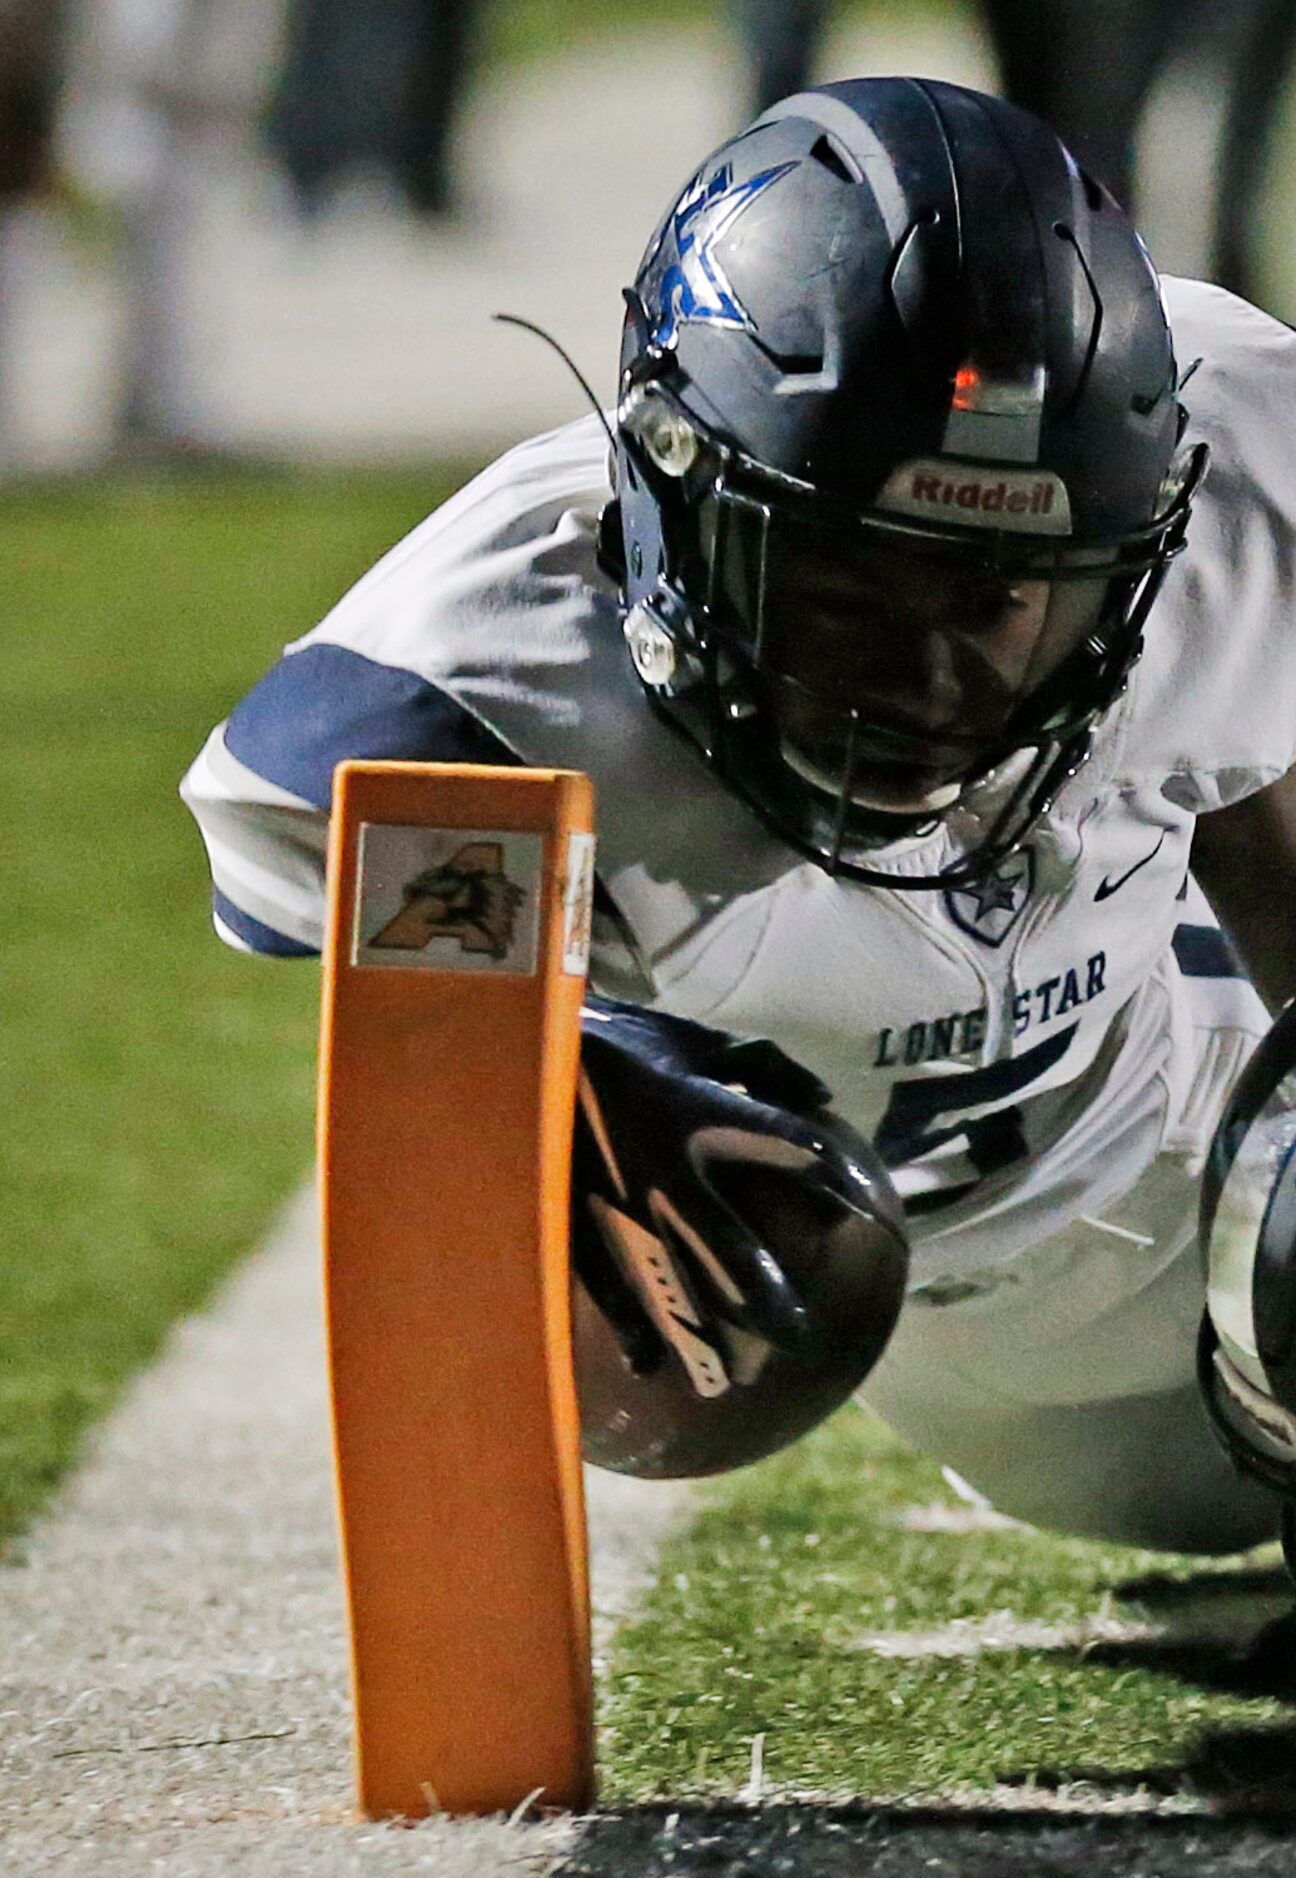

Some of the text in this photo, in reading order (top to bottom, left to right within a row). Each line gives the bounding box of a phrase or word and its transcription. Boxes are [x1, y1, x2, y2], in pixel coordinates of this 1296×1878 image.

[911, 475, 1055, 514] Riddell
[872, 950, 1107, 1067] LONE STAR
